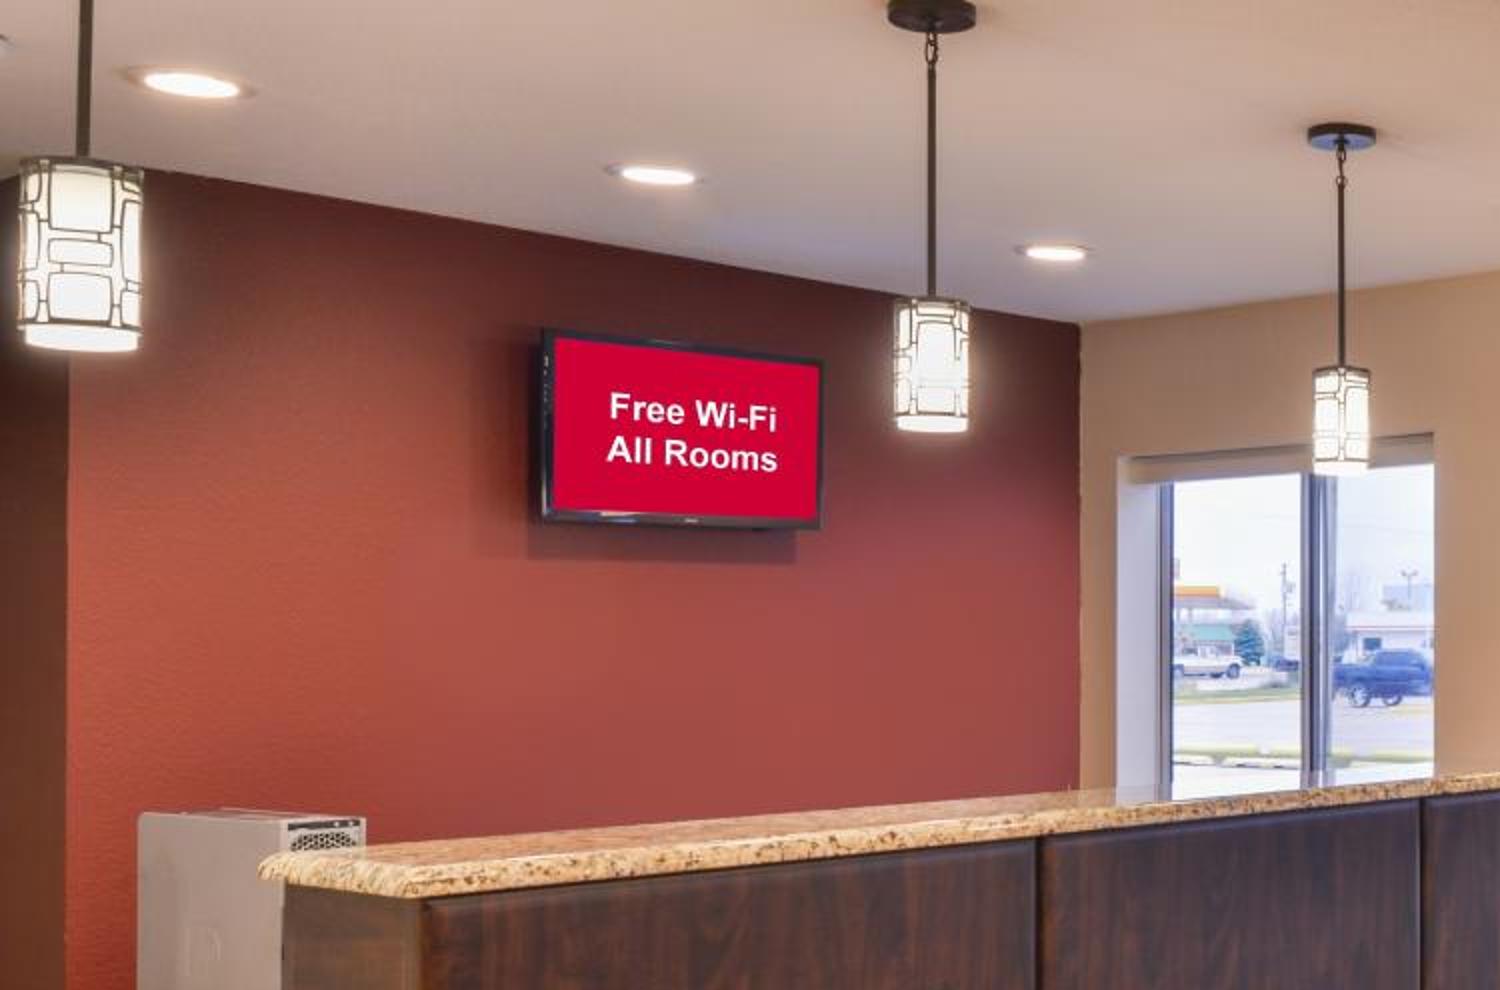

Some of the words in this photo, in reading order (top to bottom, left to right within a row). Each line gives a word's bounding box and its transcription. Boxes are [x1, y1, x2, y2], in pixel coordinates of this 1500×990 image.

[610, 392, 685, 425] Free
[695, 400, 777, 434] Wi-Fi
[606, 435, 652, 464] All
[665, 439, 778, 472] Rooms
